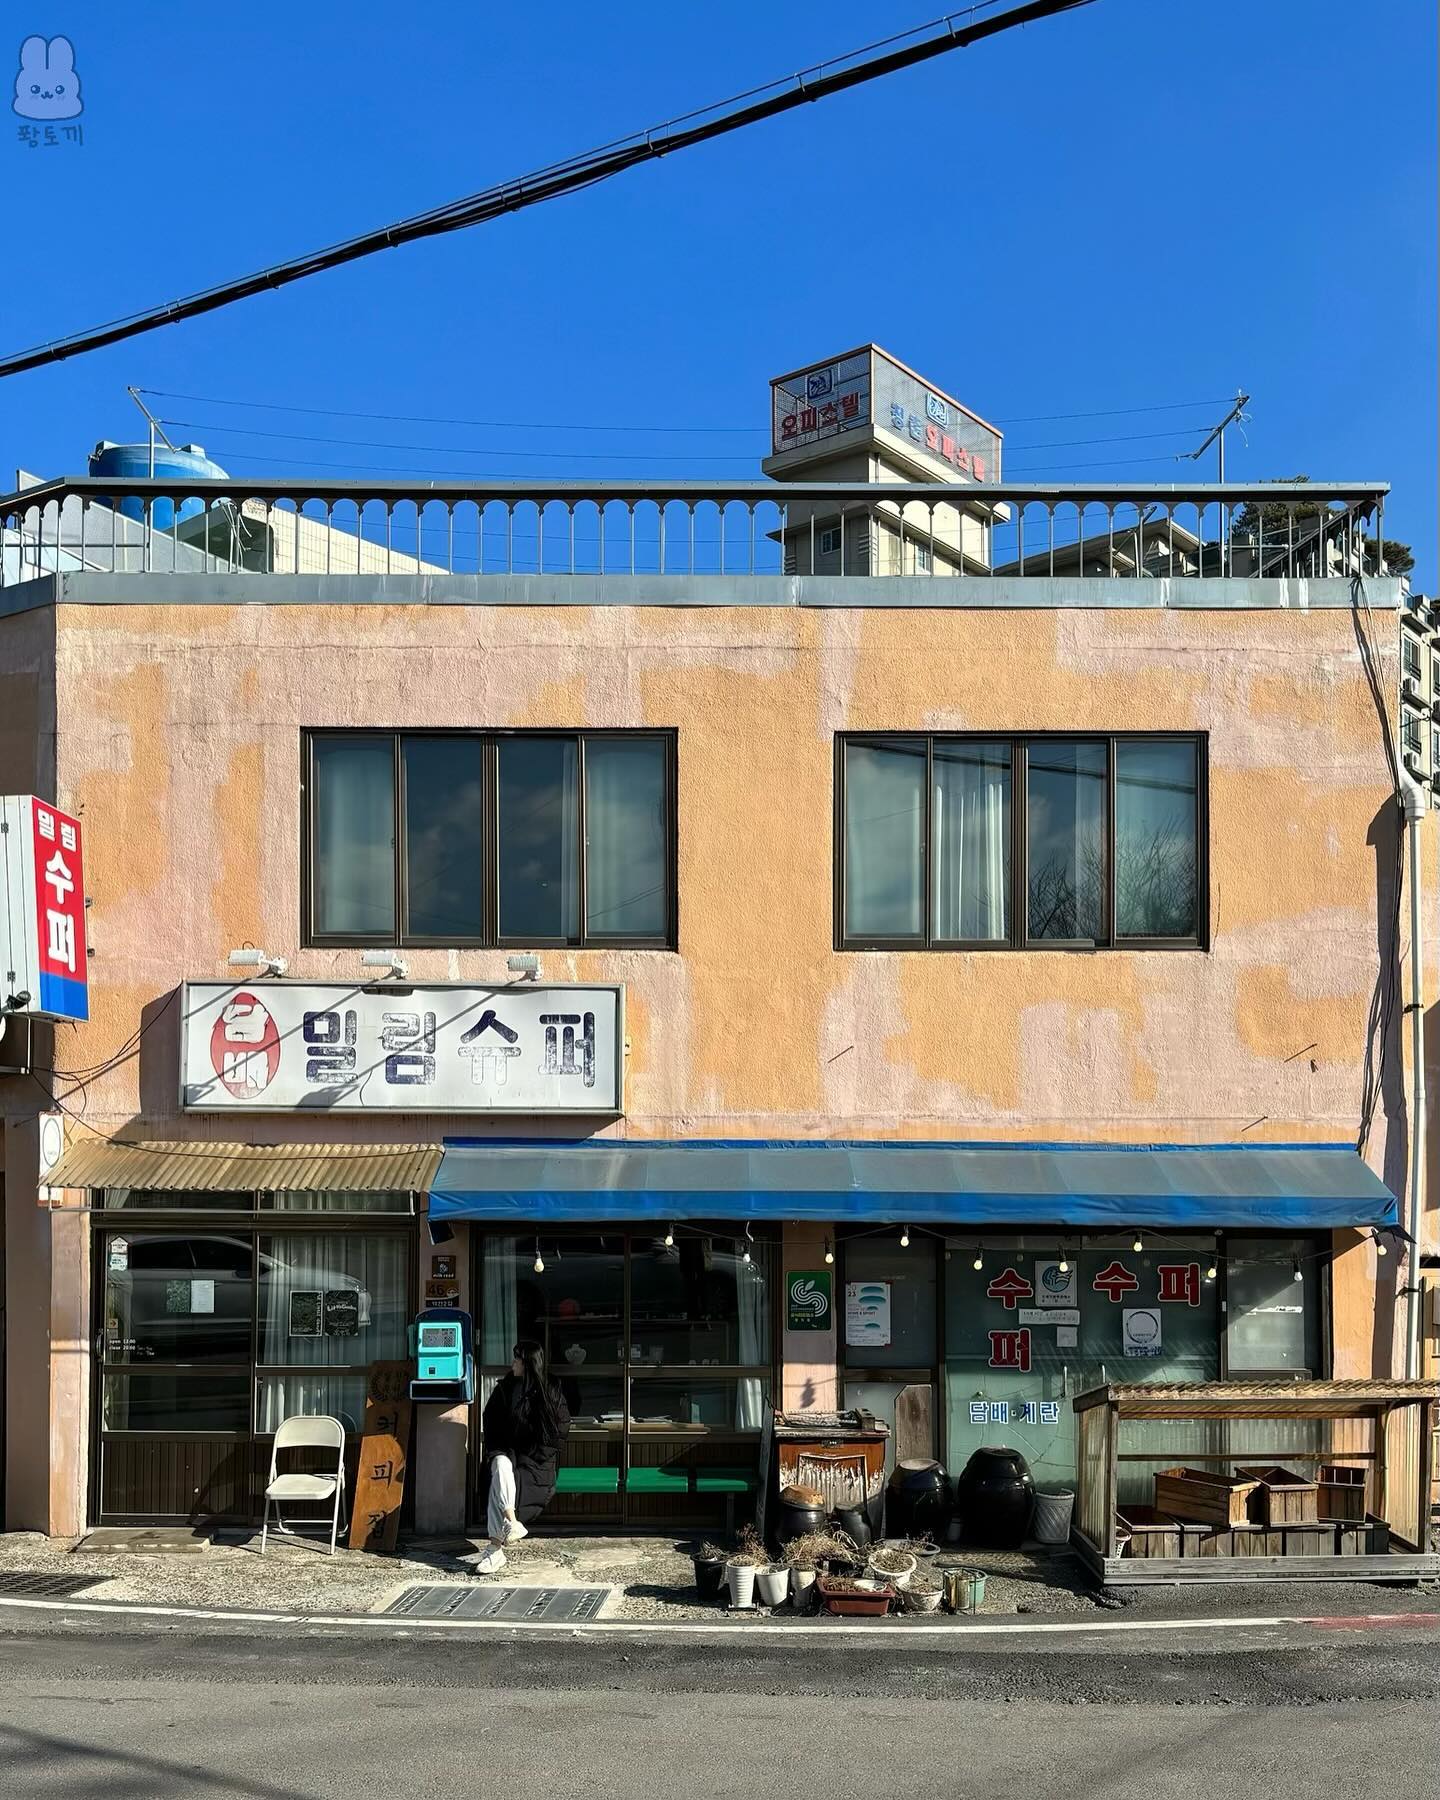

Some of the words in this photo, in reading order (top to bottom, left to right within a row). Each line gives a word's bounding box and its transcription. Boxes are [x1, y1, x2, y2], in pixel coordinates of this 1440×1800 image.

[781, 391, 860, 441] 오피스텔
[925, 424, 985, 483] 오피스텔
[37, 808, 76, 852] 밀림
[45, 849, 76, 973] 수퍼
[303, 1009, 596, 1088] 밀림슈퍼
[430, 1284, 445, 1296] 46
[1092, 1260, 1201, 1307] 수퍼
[987, 1267, 1033, 1373] 수퍼
